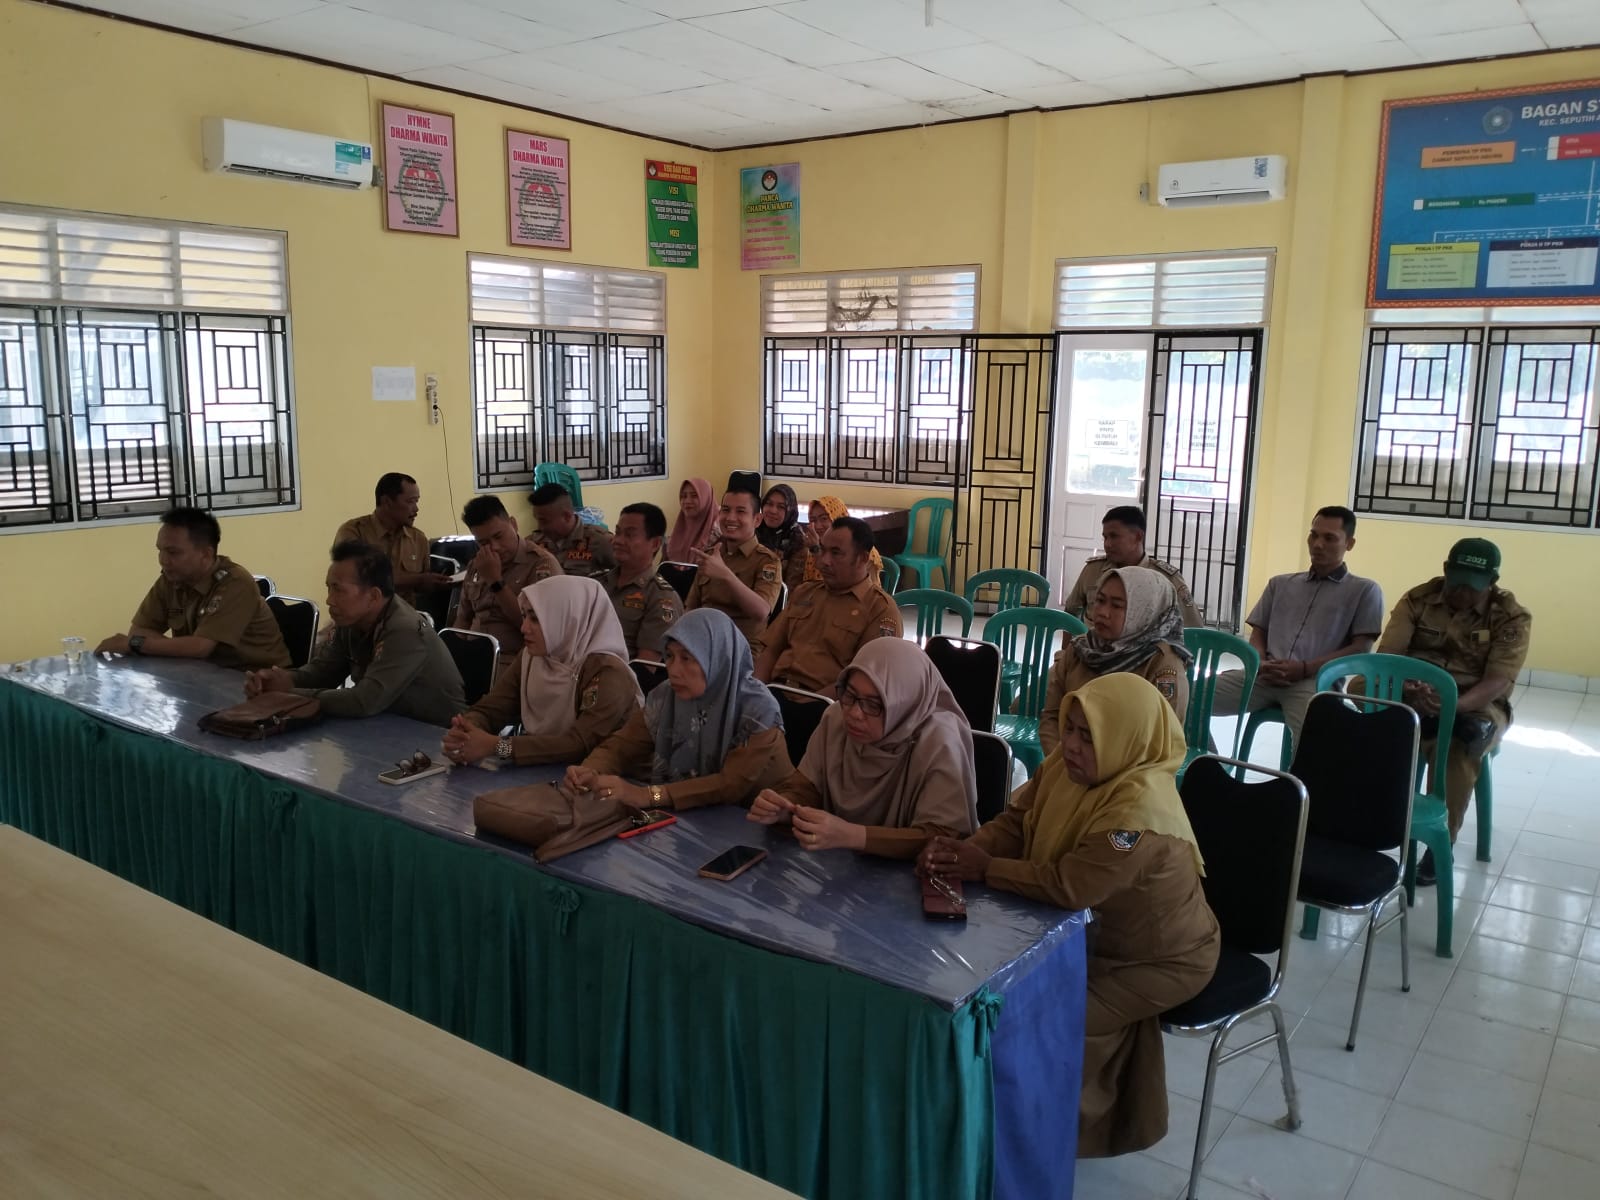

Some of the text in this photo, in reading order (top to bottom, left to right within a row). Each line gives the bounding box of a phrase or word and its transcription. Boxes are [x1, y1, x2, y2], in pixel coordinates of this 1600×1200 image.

[1521, 100, 1582, 119] BAGAN
[1586, 99, 1600, 113] S
[407, 114, 431, 129] HYMNE
[1559, 115, 1595, 125] SEPUTIH
[390, 126, 448, 147] DHARMA WANITA
[529, 139, 548, 152] MARS
[513, 150, 564, 168] DHARMA WANITA
[668, 186, 679, 195] VISI
[670, 229, 680, 237] MISI
